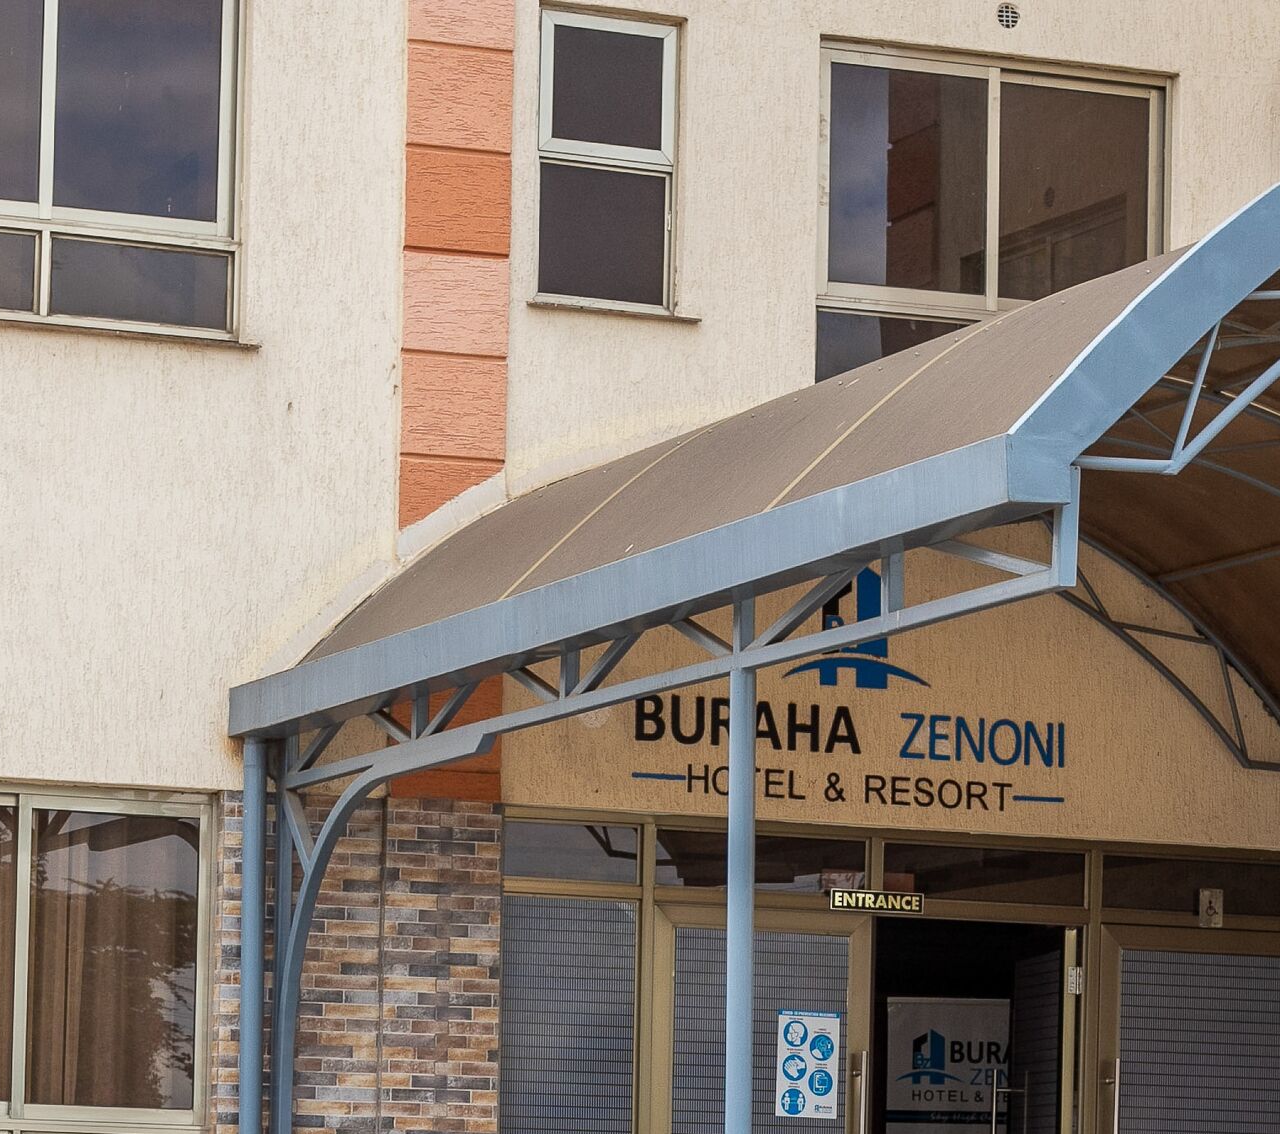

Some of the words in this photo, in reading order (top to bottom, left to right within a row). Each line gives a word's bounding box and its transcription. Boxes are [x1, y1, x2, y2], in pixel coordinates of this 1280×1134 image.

[899, 712, 1065, 769] ZENONI
[687, 763, 806, 800] HOEL
[824, 772, 847, 802] &
[864, 774, 1014, 812] RESORT
[834, 891, 920, 911] ENTRANCE
[911, 1089, 969, 1103] HOTEL
[974, 1090, 985, 1103] &
